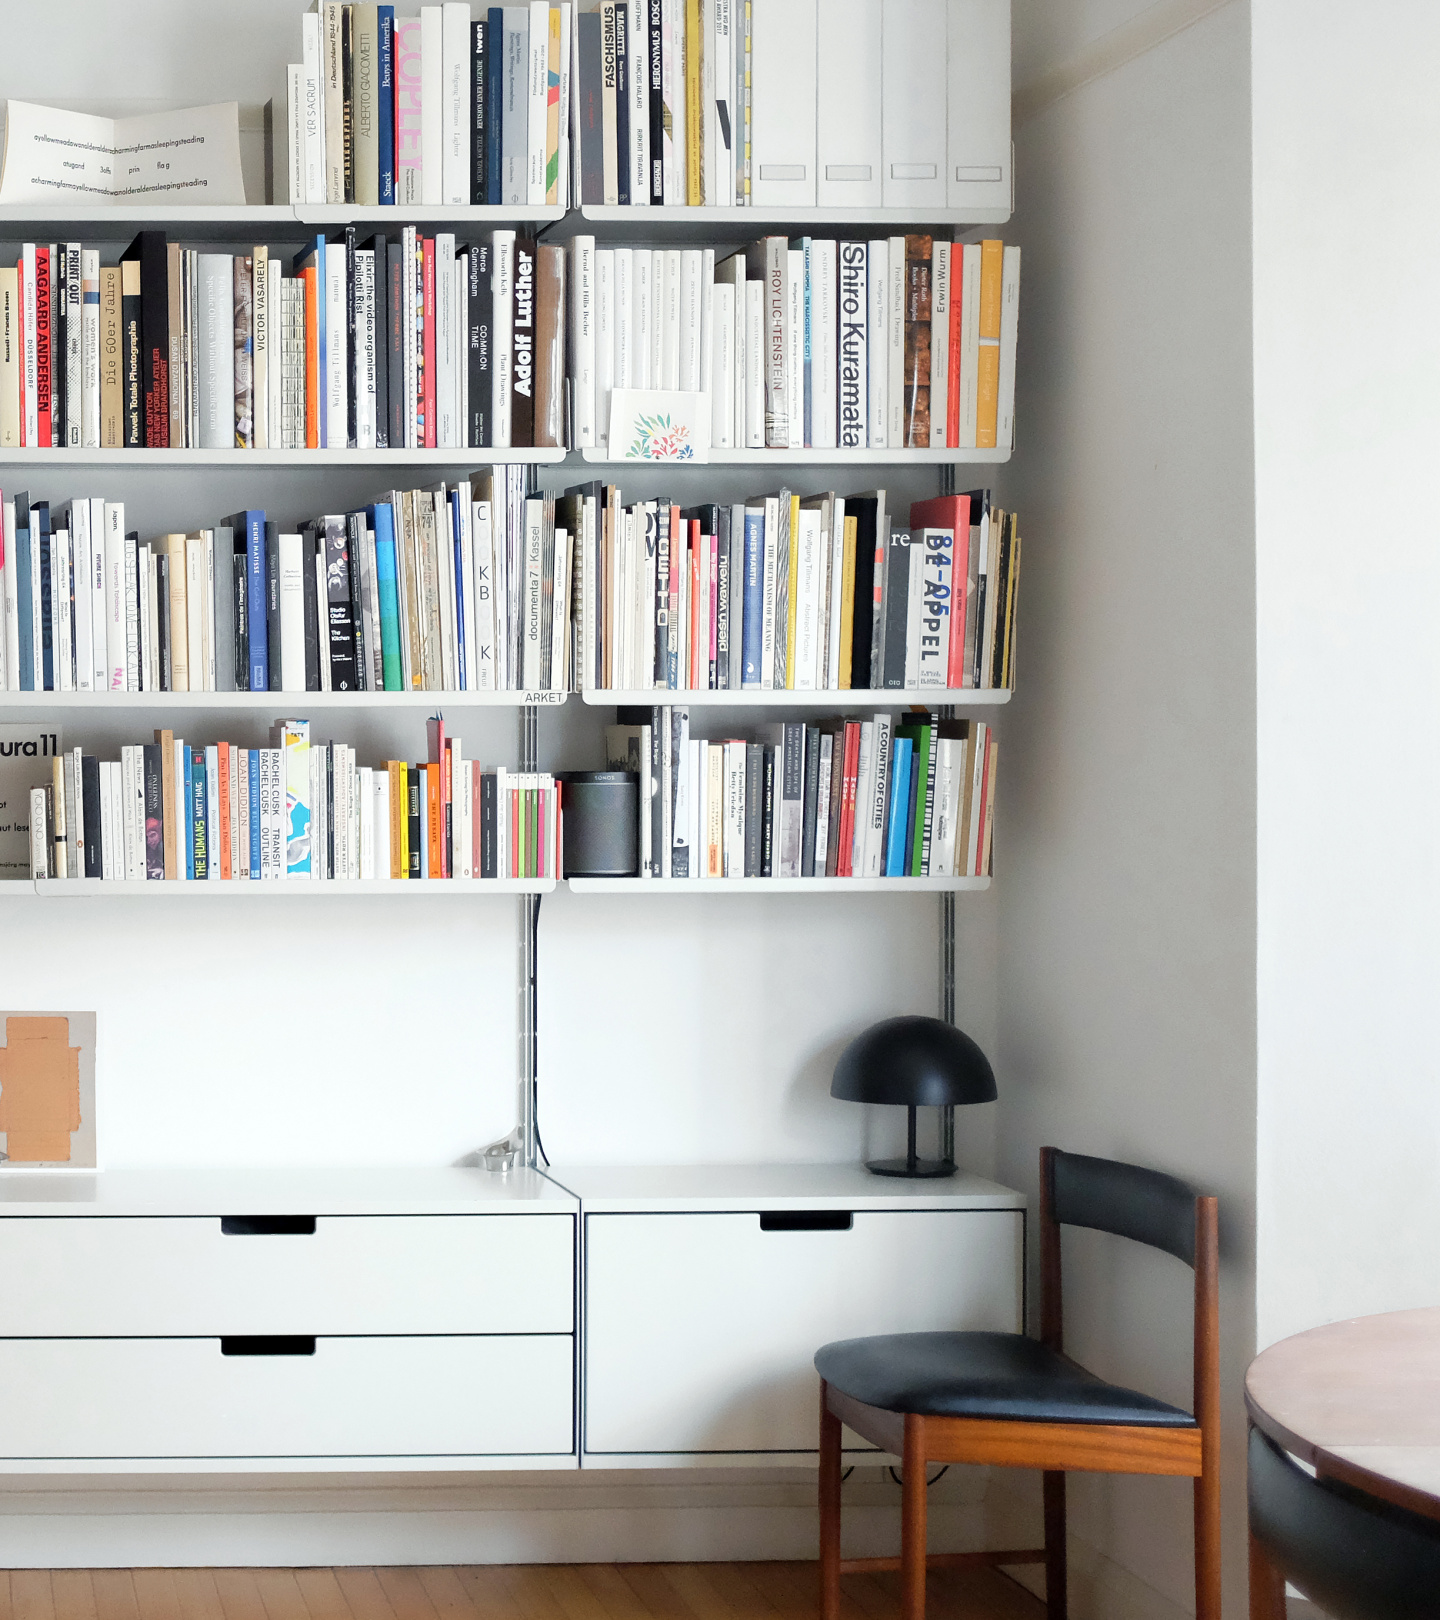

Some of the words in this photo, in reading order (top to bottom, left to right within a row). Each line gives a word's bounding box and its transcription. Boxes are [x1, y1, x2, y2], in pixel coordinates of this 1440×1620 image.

[382, 17, 390, 52] Amerika
[605, 7, 614, 88] FASCHISMUS
[361, 34, 371, 90] GIACOMETTI
[382, 54, 390, 62] in
[382, 64, 390, 87] Beuys
[361, 93, 371, 138] ALBERTO
[356, 255, 364, 292] Pipilotti
[366, 255, 374, 282] Elixir:
[842, 246, 864, 314] Shiro
[937, 249, 946, 280] Wurm
[38, 256, 48, 330] AAGAARD
[106, 273, 116, 314] Jahre
[366, 285, 374, 300] the
[514, 251, 532, 327] Luther
[773, 270, 782, 294] ROY
[937, 283, 946, 312] Erwin
[356, 296, 364, 314] Rist
[366, 304, 374, 331] video
[106, 321, 116, 354] 60er
[130, 321, 138, 381] Photographie
[773, 300, 782, 390] LICHTENSTEIN
[38, 333, 48, 412] ANDERSEN
[106, 361, 116, 384] Die
[366, 334, 374, 381] organism
[514, 334, 532, 397] Adolf
[130, 383, 138, 409] Totale
[366, 384, 374, 393] of
[842, 323, 864, 446] Kuramata
[130, 412, 138, 443] Pawek
[529, 527, 540, 561] Kassel
[529, 579, 540, 640] documenta
[524, 693, 563, 703] ARKET
[878, 730, 888, 781] COUNTRY
[877, 783, 885, 795] OF
[874, 797, 884, 829] CITIES
[195, 821, 205, 858] HUMANS
[195, 860, 206, 877] THE
